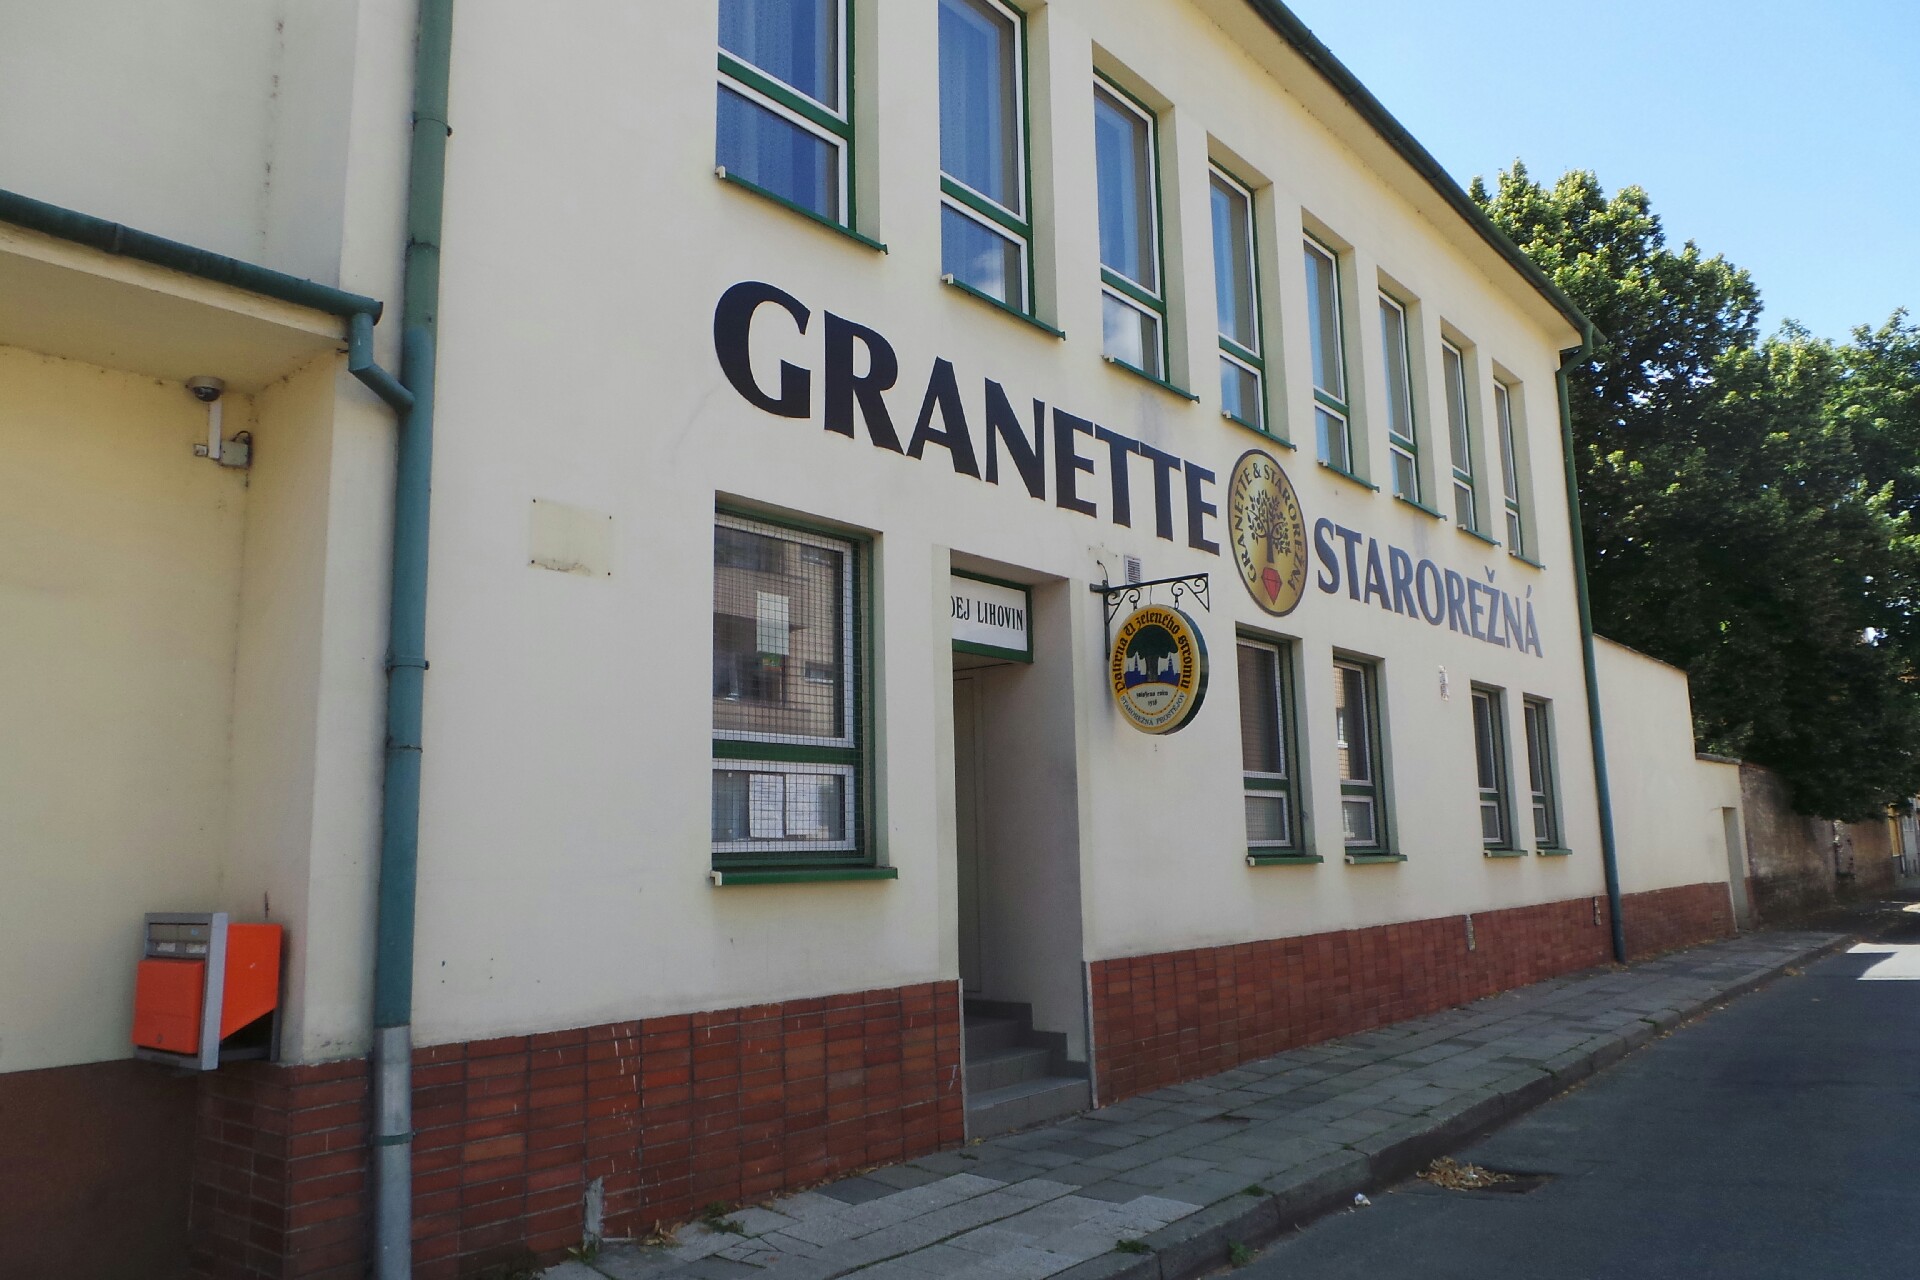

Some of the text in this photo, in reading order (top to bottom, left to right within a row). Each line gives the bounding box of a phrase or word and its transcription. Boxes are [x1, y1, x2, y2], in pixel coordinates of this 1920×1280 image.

[714, 281, 1220, 557] GRANETTE
[1234, 467, 1257, 583] GRANETTE
[1253, 462, 1261, 479] &
[977, 601, 1023, 631] LIHOVIN
[1314, 518, 1543, 658] STAROREŽNÁ
[1178, 635, 1193, 689] stromu
